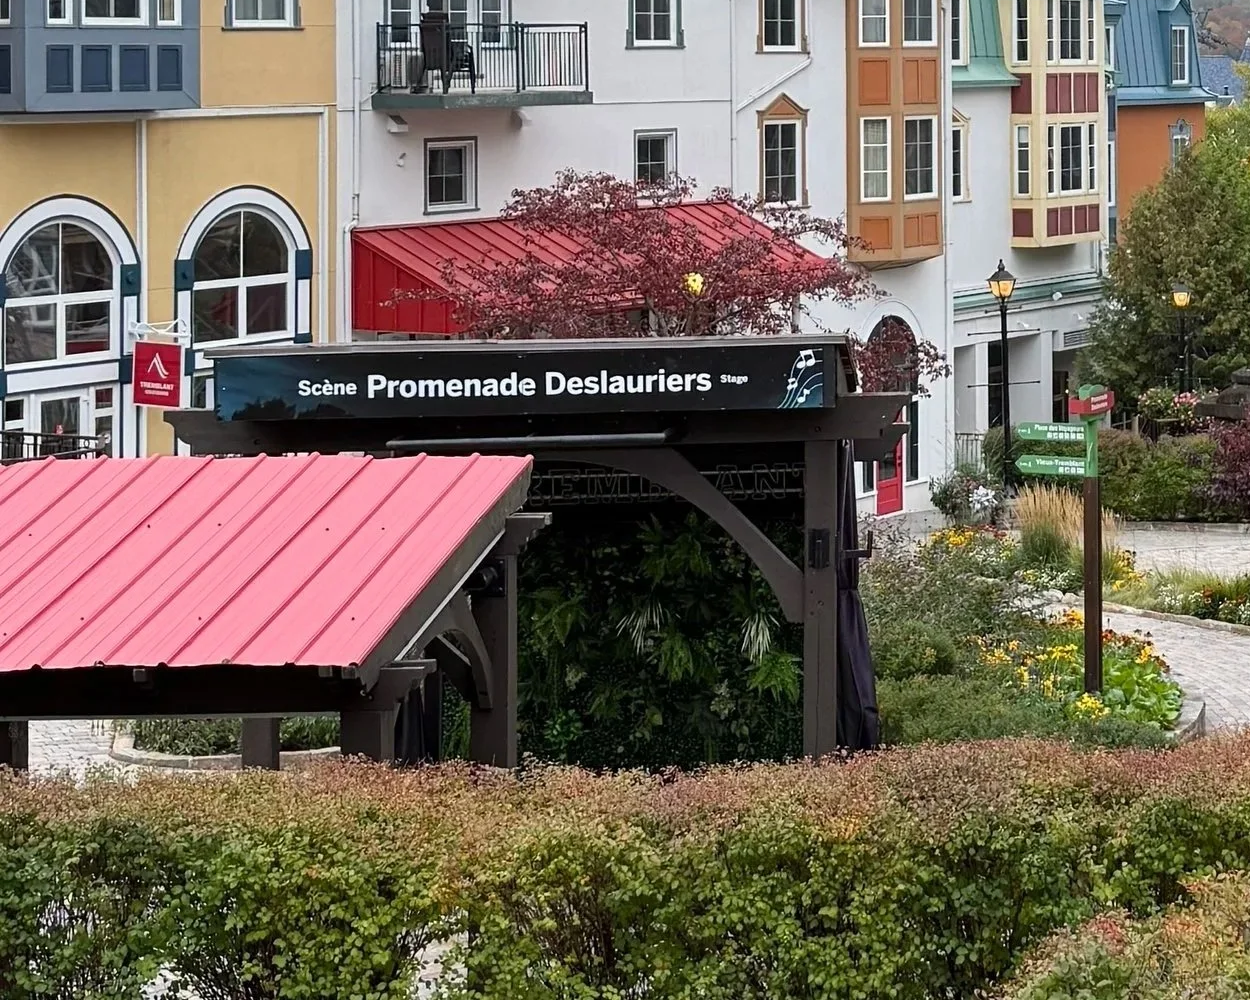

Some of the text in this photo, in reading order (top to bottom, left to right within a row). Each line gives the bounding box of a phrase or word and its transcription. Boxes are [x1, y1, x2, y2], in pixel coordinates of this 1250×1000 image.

[298, 368, 749, 399] Scène Promenade Deslauriers Stage
